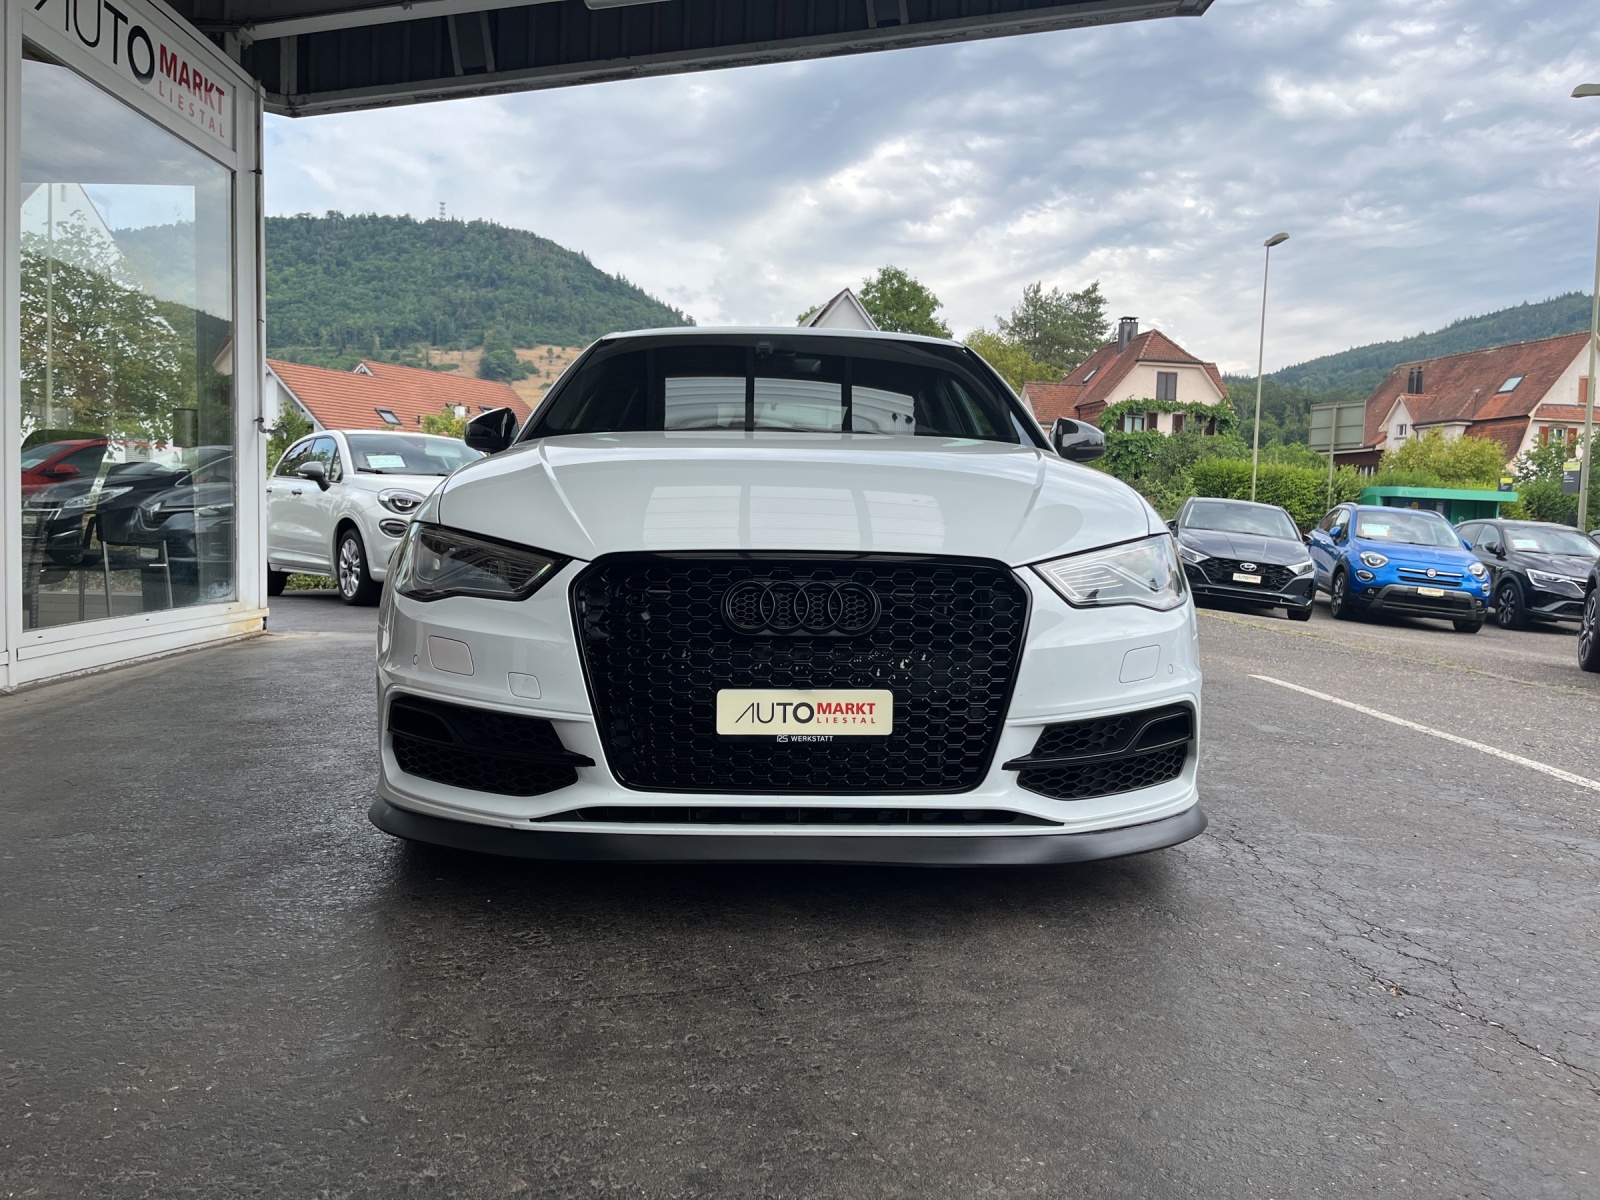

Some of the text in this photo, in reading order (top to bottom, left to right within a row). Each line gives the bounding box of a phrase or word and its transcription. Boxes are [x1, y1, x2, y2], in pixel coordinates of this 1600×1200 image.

[159, 43, 225, 115] MARKT
[158, 80, 225, 138] LIESTAL
[735, 702, 876, 724] AUTO MARKT
